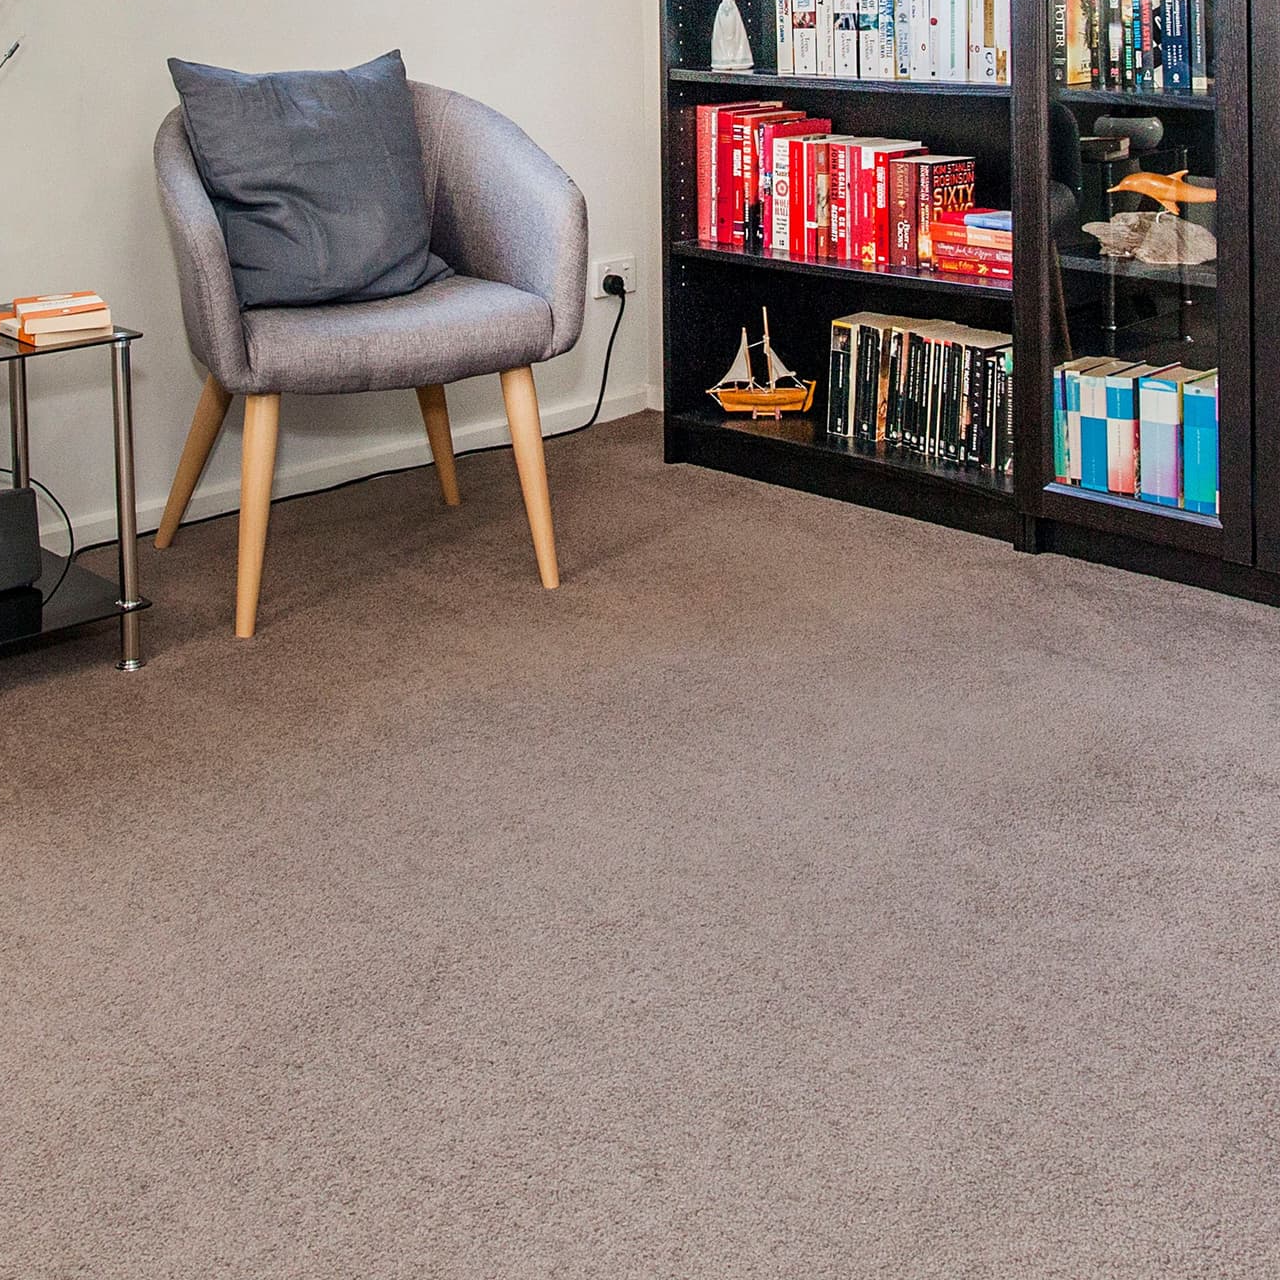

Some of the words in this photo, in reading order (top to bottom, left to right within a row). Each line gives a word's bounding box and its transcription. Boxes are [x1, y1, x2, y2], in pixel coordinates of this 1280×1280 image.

[778, 16, 785, 24] OF
[1055, 3, 1066, 49] POTTER
[1142, 25, 1151, 52] ASTLE
[743, 125, 752, 179] WILDMAN
[829, 148, 837, 170] JOHN
[838, 150, 846, 169] JOHN
[896, 164, 905, 199] MARTIN
[933, 164, 947, 175] KIM
[948, 161, 976, 173] STANLEY
[933, 171, 975, 186] ROBINSON
[829, 173, 837, 201] SCALZI
[838, 171, 846, 199] SCALZI
[933, 184, 975, 206] SIXTY
[829, 204, 838, 243] REDSHIRTS
[838, 229, 846, 238] IN
[897, 221, 906, 248] CROWS
[973, 349, 981, 417] ARRIVAL
